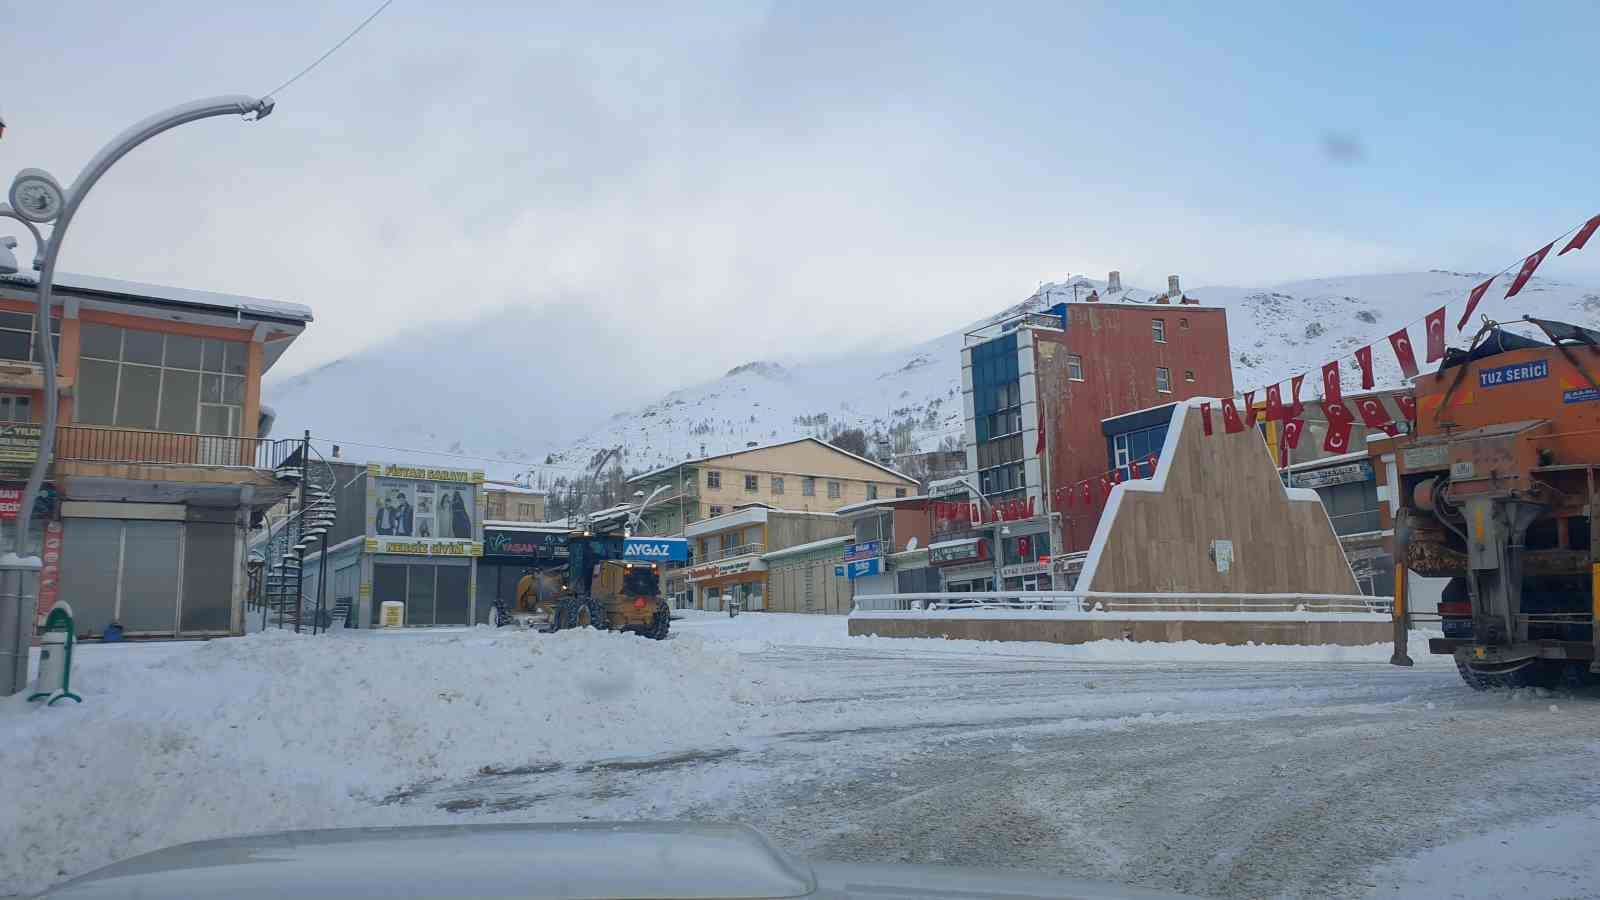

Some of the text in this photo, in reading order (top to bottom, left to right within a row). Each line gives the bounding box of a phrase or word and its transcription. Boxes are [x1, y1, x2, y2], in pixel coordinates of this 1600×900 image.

[1481, 361, 1547, 385] TUZ SERİCİ
[624, 544, 671, 557] AYGAZ
